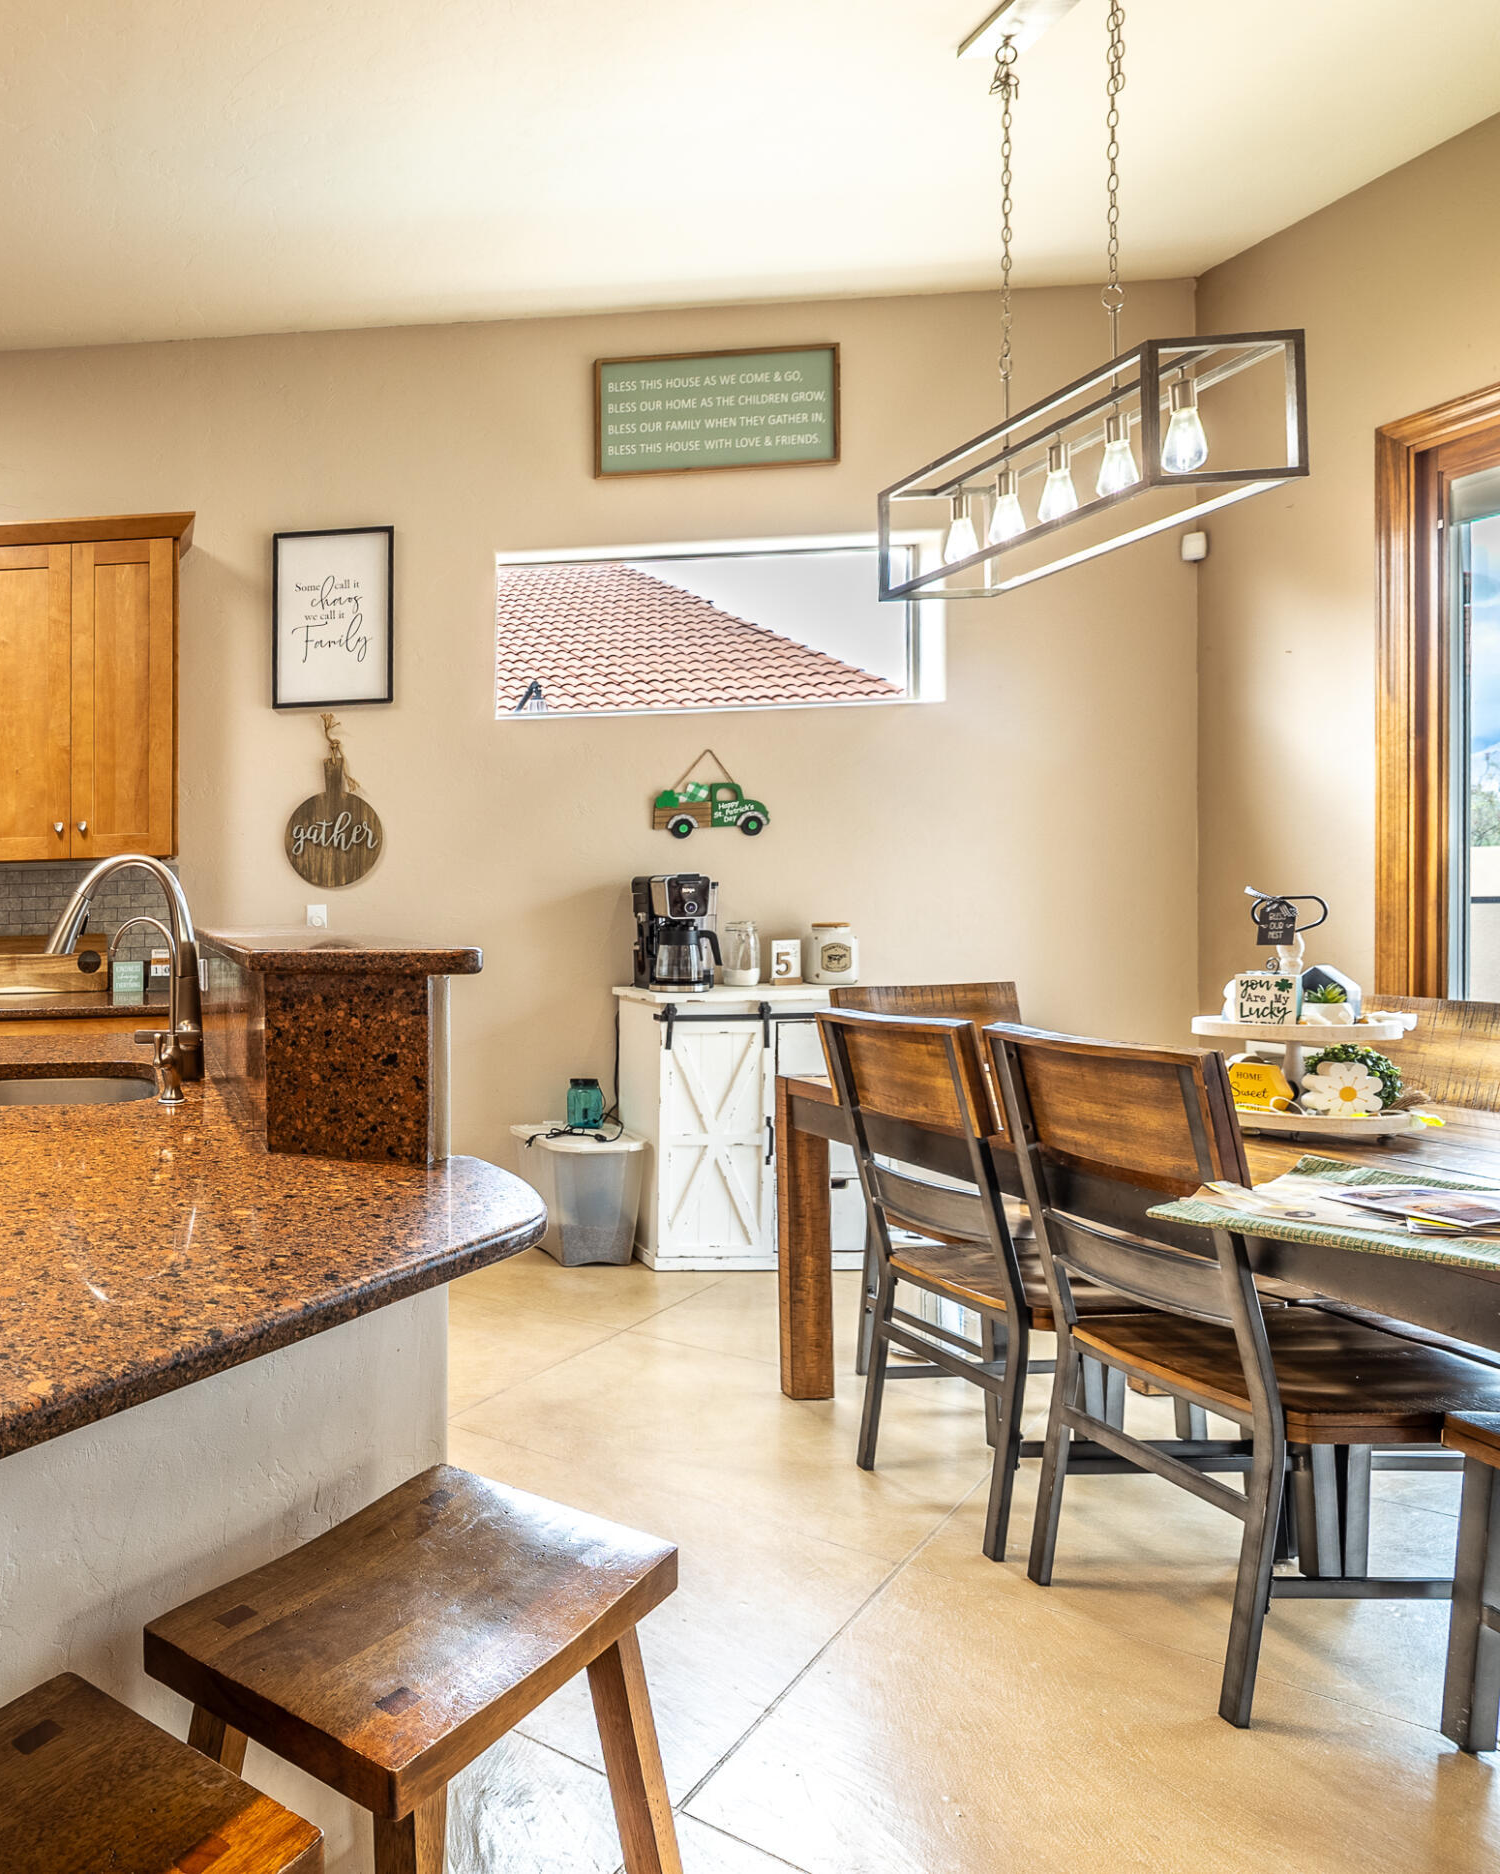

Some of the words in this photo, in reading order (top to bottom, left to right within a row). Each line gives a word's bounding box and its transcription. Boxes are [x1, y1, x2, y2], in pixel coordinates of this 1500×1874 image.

[608, 381, 637, 393] BLESS
[640, 379, 662, 390] THIS
[666, 376, 700, 388] HOUSE
[704, 375, 716, 386] AS
[720, 374, 736, 385] WE
[739, 373, 770, 384] COME
[774, 371, 781, 381] &
[784, 370, 803, 382] GO,
[608, 402, 637, 414] BLESS
[640, 401, 662, 412] OUR
[666, 398, 697, 410] HOME
[700, 397, 713, 407] AS
[716, 396, 735, 406] THE
[738, 394, 788, 405] CHILDREN
[791, 391, 826, 402] GROW,
[608, 424, 636, 435] BLESS
[640, 422, 661, 433] OUR
[665, 419, 701, 431] FAMILY
[704, 418, 737, 429] WHEN
[740, 416, 765, 426] THEY
[768, 413, 809, 425] GATHER
[812, 413, 826, 423] IN,
[608, 445, 636, 456] BLESS
[640, 443, 661, 453] THIS
[665, 441, 700, 452] HOUSE
[704, 439, 732, 450] WITH
[735, 437, 761, 448] LOVE
[764, 436, 772, 446] &
[294, 583, 321, 592] Some
[335, 580, 350, 589] call
[353, 580, 359, 589] it
[311, 575, 363, 614] chaos
[320, 610, 336, 620] call
[339, 611, 345, 619] it
[292, 613, 372, 663] Family
[292, 811, 378, 855] gather
[776, 952, 792, 975] 5
[1240, 980, 1273, 998] you
[1246, 993, 1266, 1002] Are
[1274, 994, 1289, 1005] My
[1240, 1000, 1292, 1024] Lucky
[1236, 1072, 1262, 1081] HOME
[1230, 1082, 1268, 1098] Sweet
